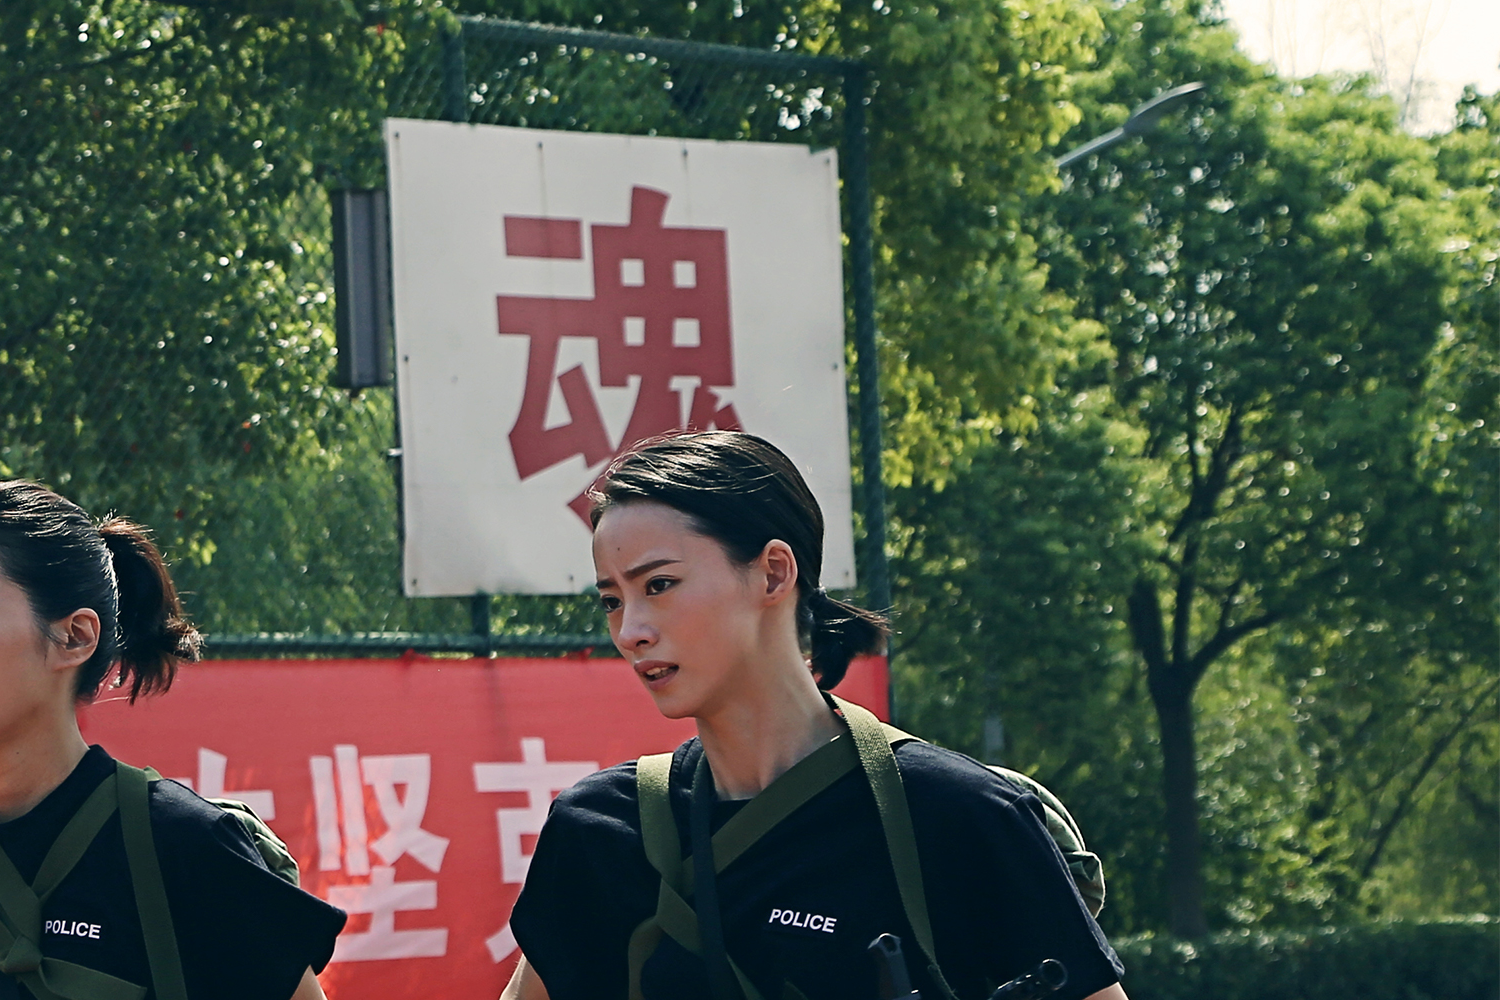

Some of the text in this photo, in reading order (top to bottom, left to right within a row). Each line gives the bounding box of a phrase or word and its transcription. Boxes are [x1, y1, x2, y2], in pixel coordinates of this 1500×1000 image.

[496, 185, 744, 534] 魂
[44, 919, 102, 940] POLICE
[768, 908, 838, 934] POLICE
